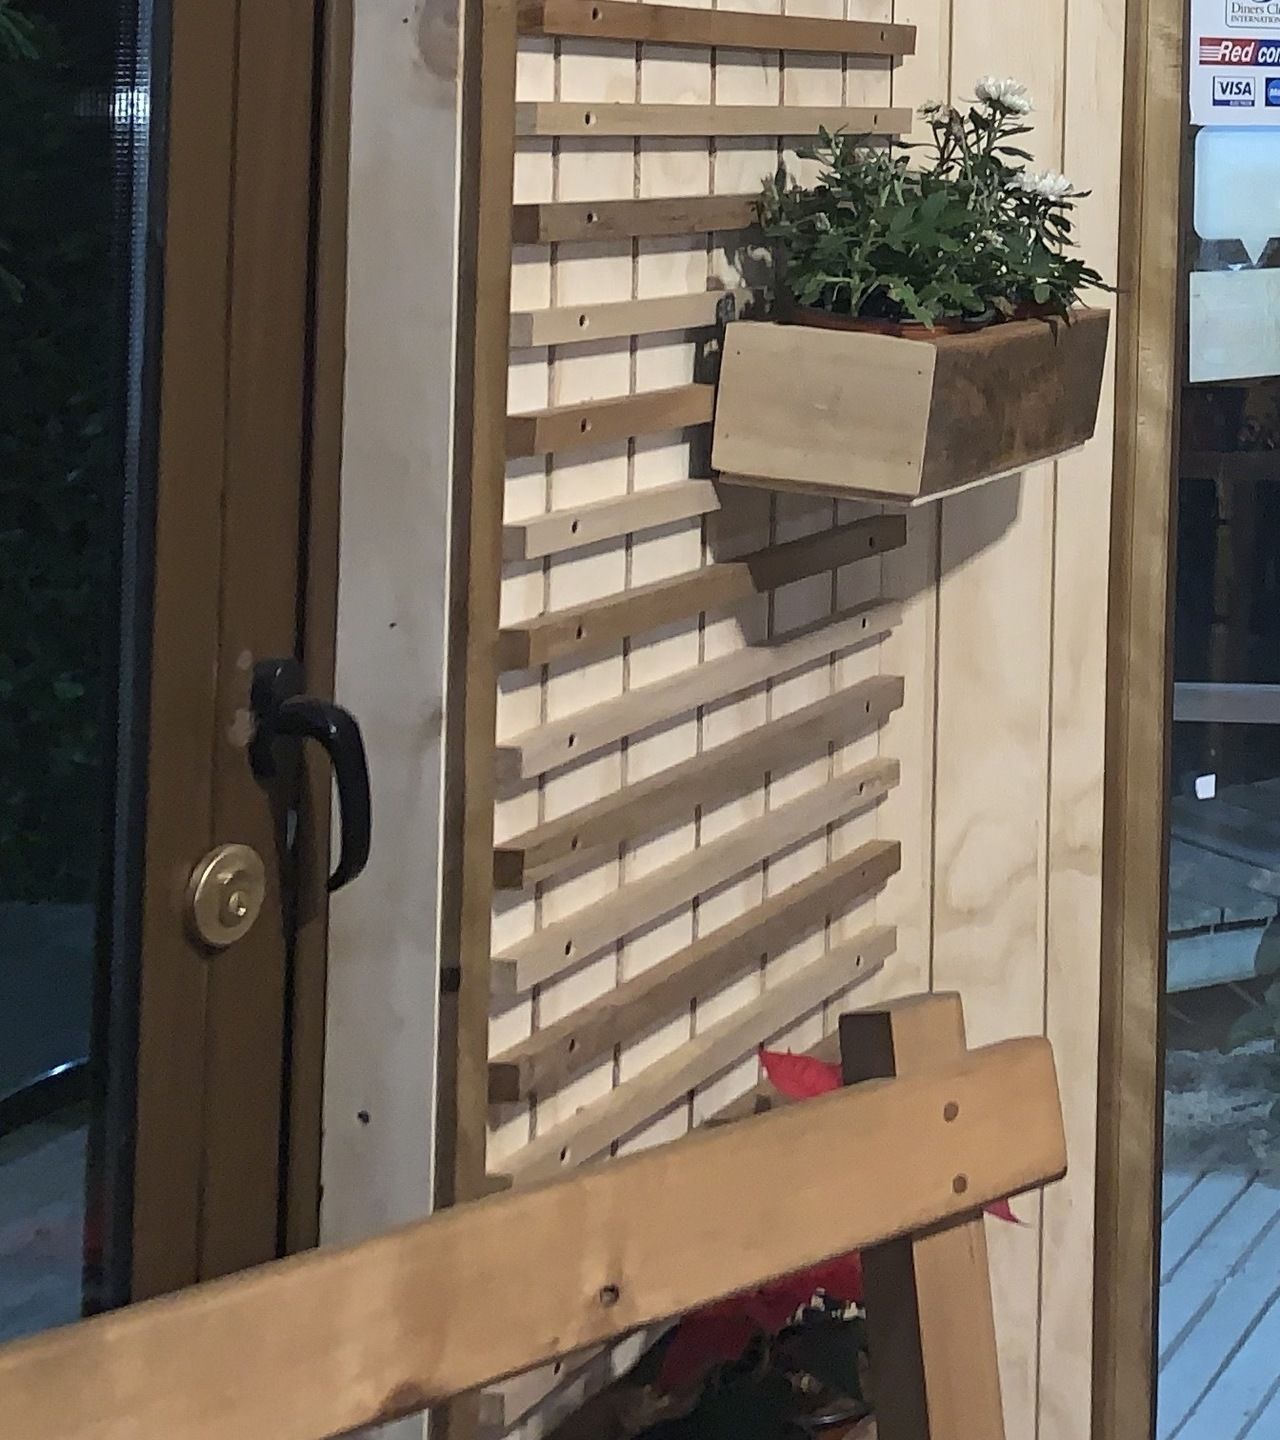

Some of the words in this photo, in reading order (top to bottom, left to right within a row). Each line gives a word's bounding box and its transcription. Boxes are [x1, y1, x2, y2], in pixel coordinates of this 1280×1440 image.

[1231, 2, 1264, 15] Diners
[1218, 41, 1255, 62] Red
[1218, 81, 1252, 96] VISA
